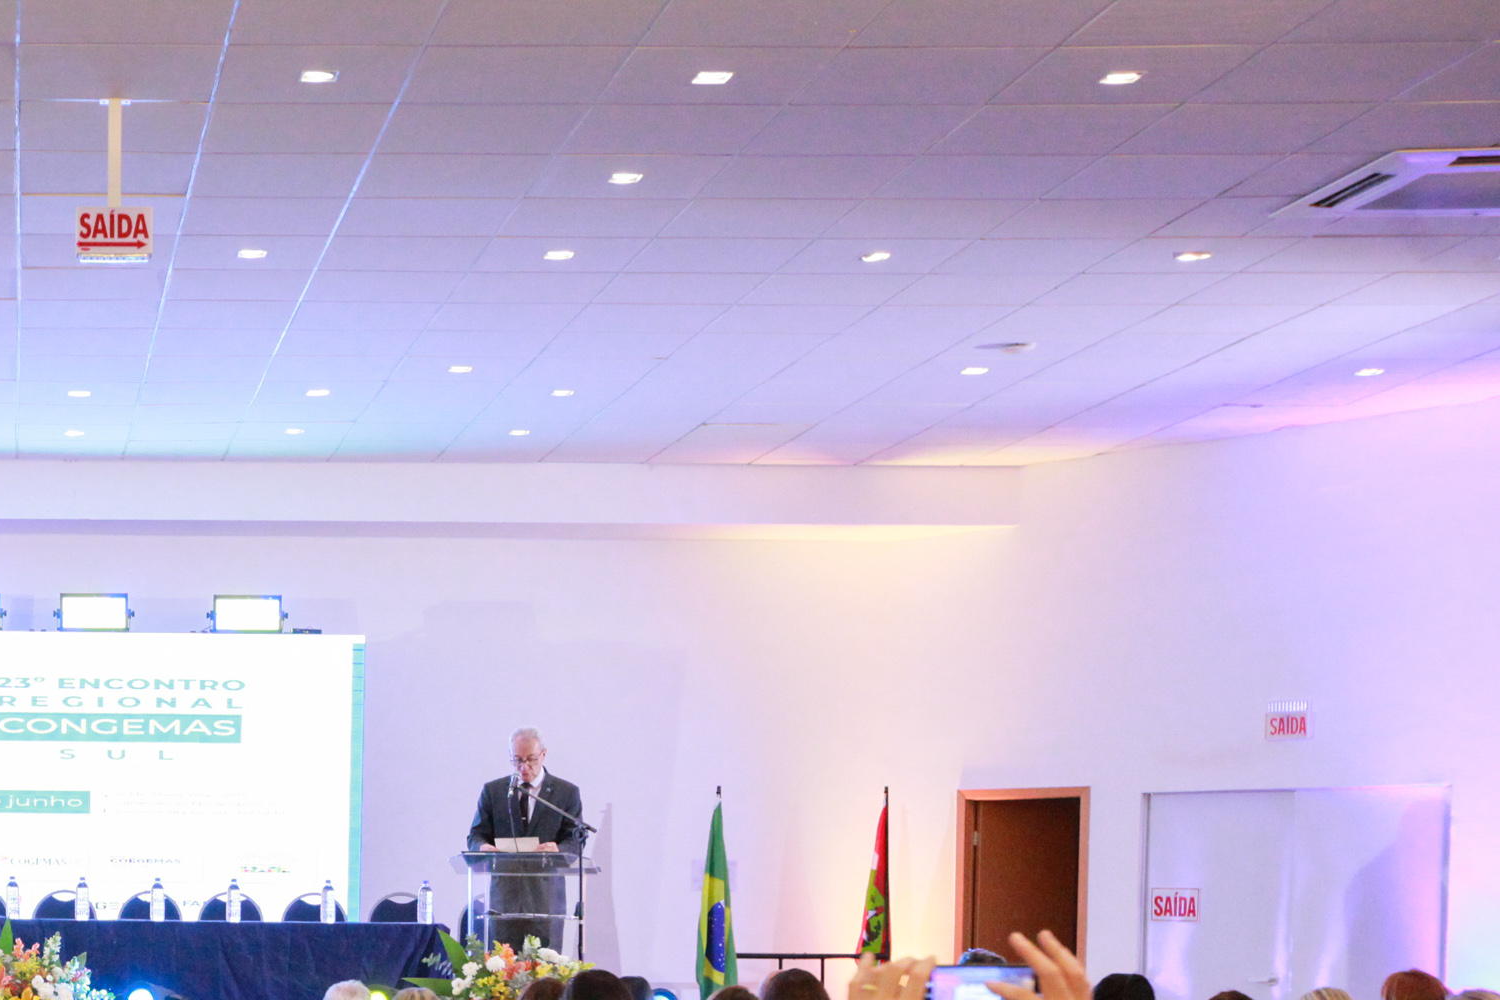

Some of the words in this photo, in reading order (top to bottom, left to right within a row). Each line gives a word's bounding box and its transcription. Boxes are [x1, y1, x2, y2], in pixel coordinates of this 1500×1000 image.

[79, 209, 149, 239] SAÍDA
[58, 677, 246, 691] ENCONTRO
[5, 794, 84, 809] junho
[1153, 891, 1196, 917] SAÍDA
